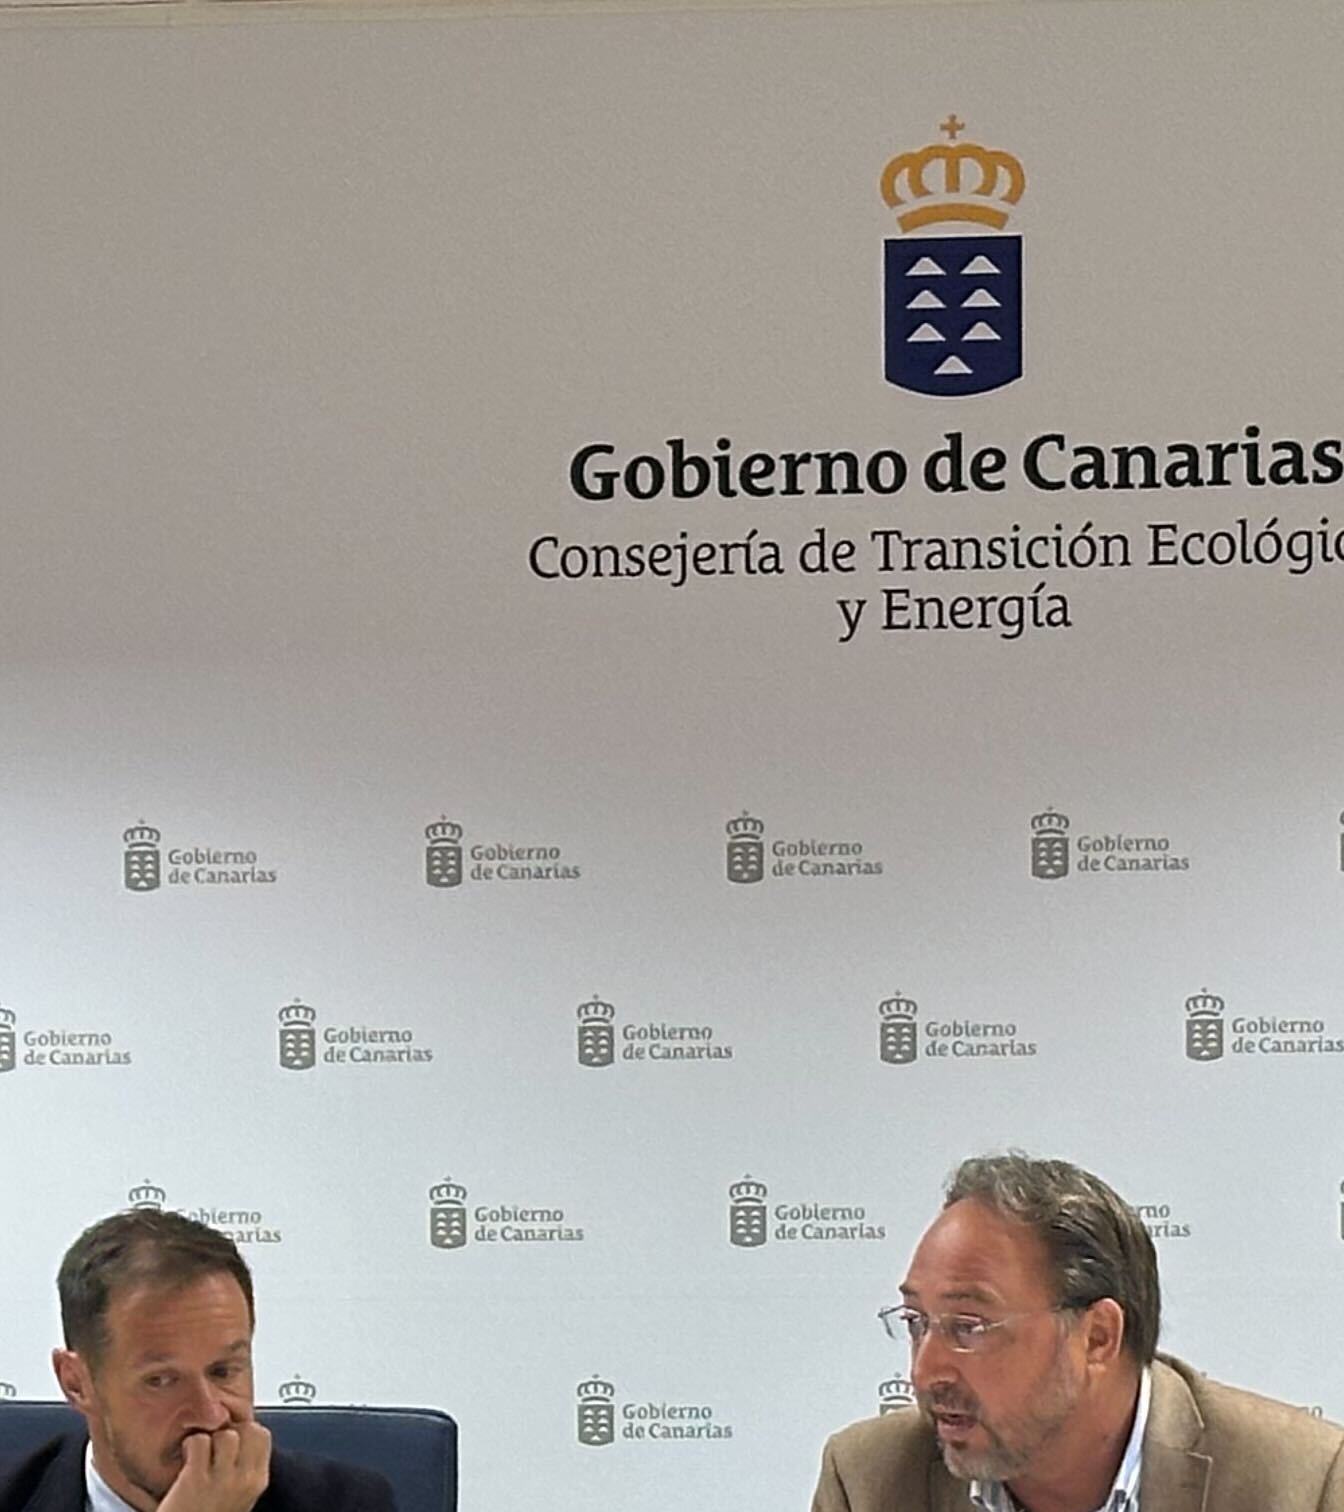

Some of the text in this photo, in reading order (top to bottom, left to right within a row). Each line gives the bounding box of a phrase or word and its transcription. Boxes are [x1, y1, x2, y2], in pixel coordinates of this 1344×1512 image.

[570, 425, 1344, 501] Gobierno de Canarias
[528, 528, 785, 588] Consejería
[799, 527, 857, 574] de
[871, 520, 1132, 573] Transición
[836, 581, 1073, 643] y Energía
[470, 843, 561, 861] Gobierno
[771, 839, 863, 857] Gobierno
[1076, 833, 1170, 853] Gobierno
[167, 847, 258, 866] Gobierno
[1076, 853, 1190, 873] de Canarias
[168, 865, 278, 885] de Canarias
[470, 862, 582, 881] de Canarias
[771, 858, 884, 877] de Canarias
[323, 1026, 413, 1044] Gobierno
[622, 1022, 713, 1041] Gobierno
[924, 1019, 1017, 1038] Gobierno
[1231, 1016, 1325, 1035] Gobierno
[23, 1029, 113, 1047] Gobierno
[1231, 1036, 1256, 1054] de
[23, 1048, 133, 1066] de Canarias
[323, 1045, 434, 1064] de Canarias
[622, 1042, 733, 1061] de Canarias
[924, 1039, 1037, 1058] de Canarias
[178, 1207, 262, 1225] obierno
[474, 1205, 565, 1223] Gobierno
[774, 1202, 866, 1221] Gobierno
[474, 1224, 585, 1242] de Canarias
[774, 1222, 886, 1241] de Canarias
[622, 1402, 713, 1420] Gobierno
[622, 1421, 733, 1440] de Canarias
